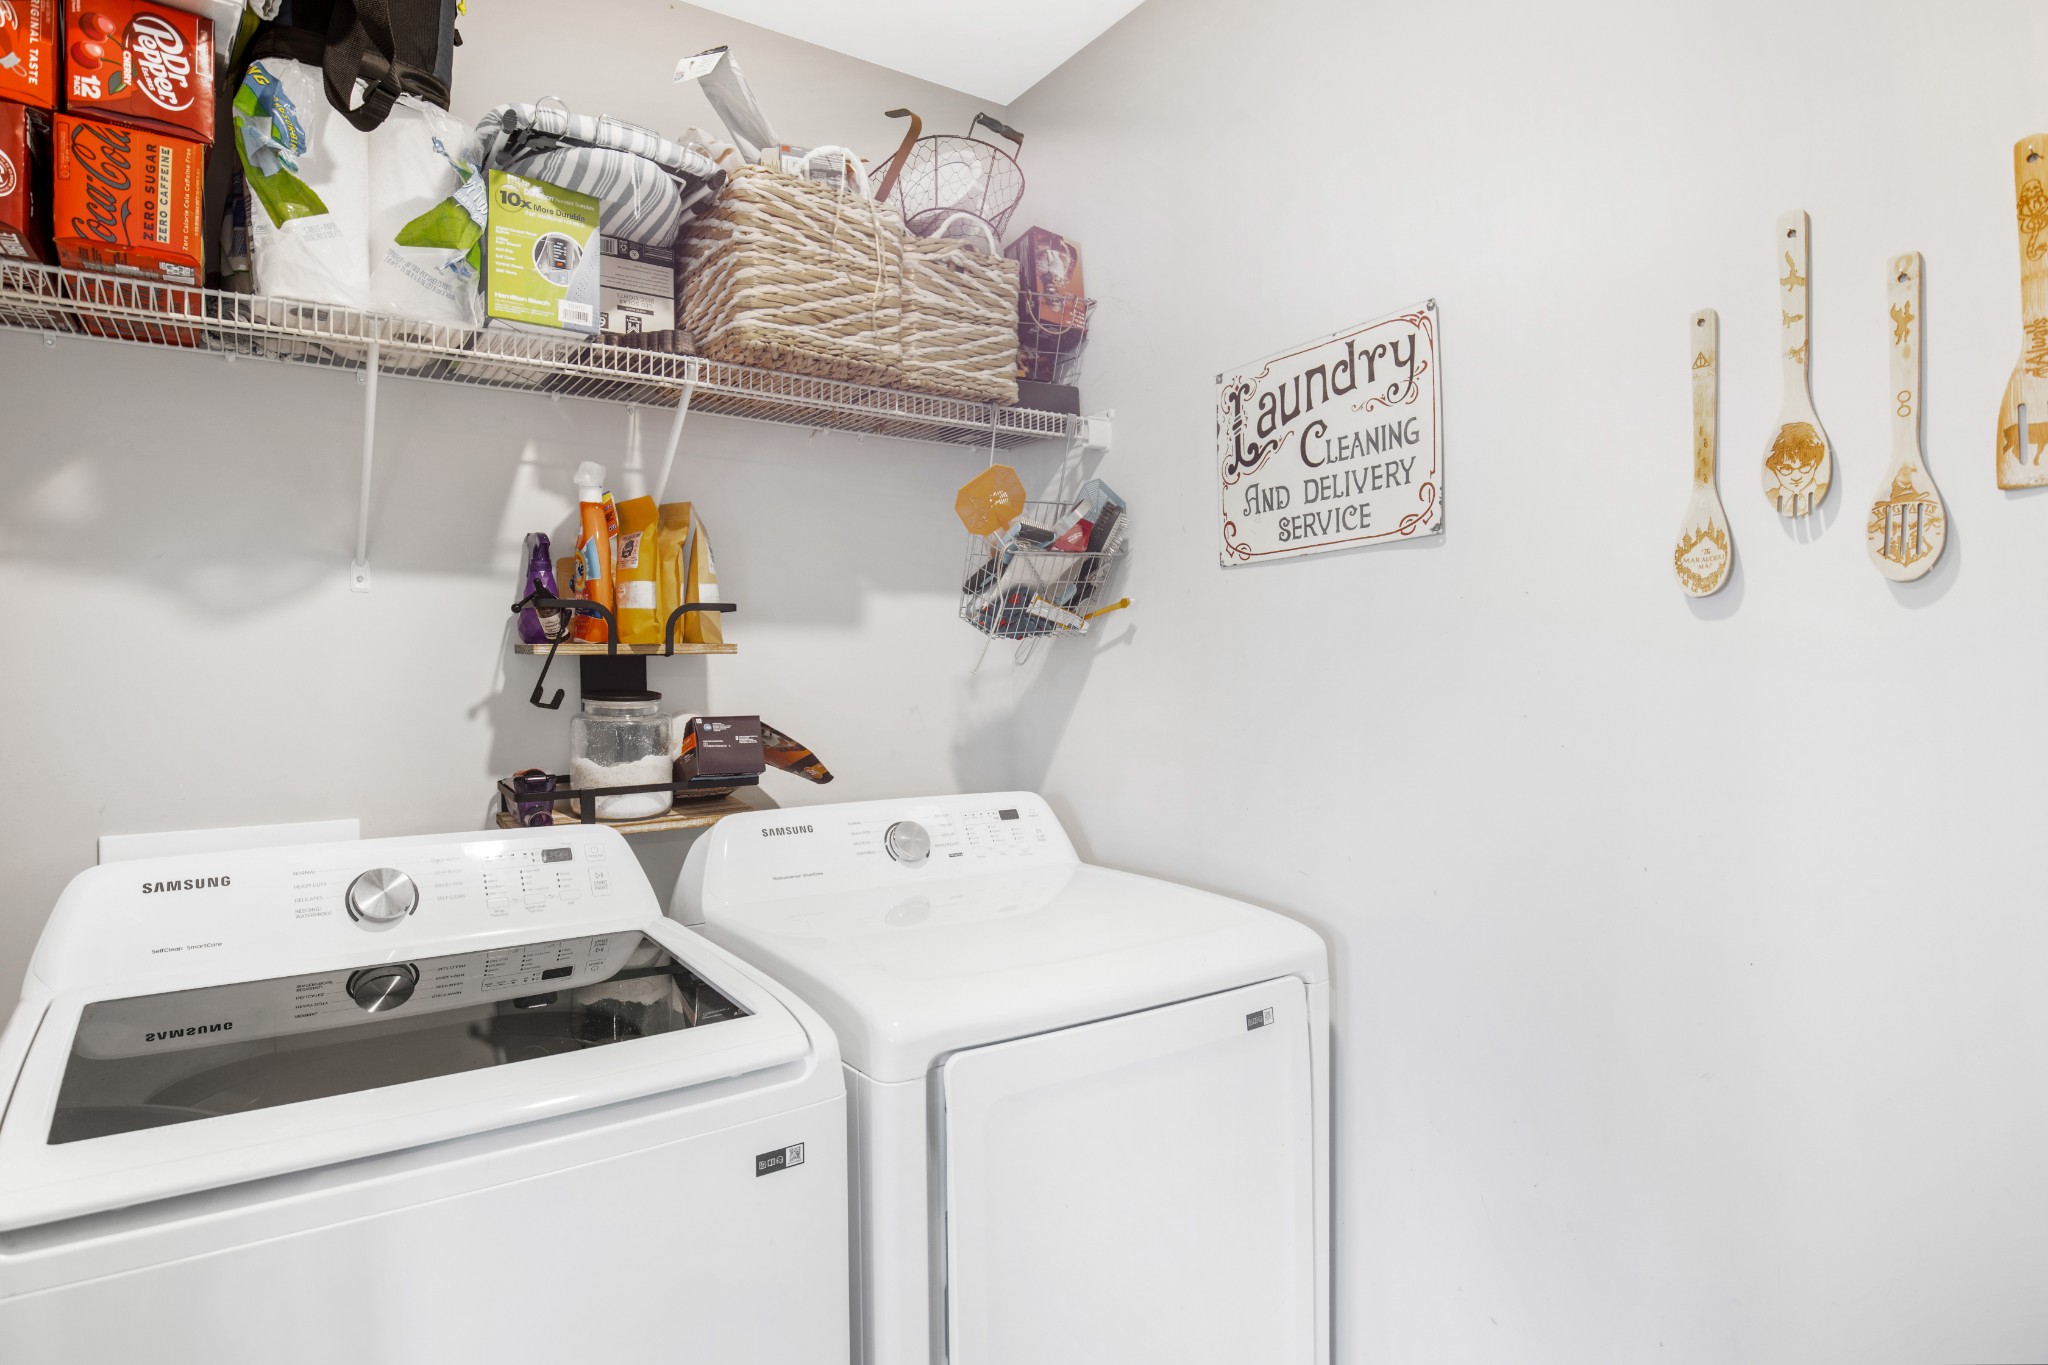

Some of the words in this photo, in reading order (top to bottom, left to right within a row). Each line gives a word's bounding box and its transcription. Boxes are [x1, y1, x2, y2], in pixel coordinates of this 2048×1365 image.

[28, 48, 38, 85] TASTE
[122, 50, 133, 86] CHERRY
[132, 17, 184, 105] Pepper
[159, 50, 190, 89] Dr
[73, 75, 82, 95] PACK
[81, 75, 101, 99] 12
[71, 122, 132, 243] Coca-Cola
[145, 144, 157, 194] SUGAR
[160, 147, 170, 206] CAFFEINE
[183, 193, 191, 208] Cola
[500, 190, 532, 210] 10x
[533, 204, 555, 216] More
[555, 209, 586, 223] Durable
[143, 201, 155, 241] ZERO
[158, 210, 168, 242] ZERO
[182, 209, 191, 234] Calorie
[182, 236, 190, 251] Zero
[494, 291, 527, 303] Hamilton
[528, 297, 551, 306] Beach
[616, 292, 639, 302] LIGHTS
[618, 299, 640, 308] SOLAR
[1227, 333, 1417, 476] Laundry
[1300, 416, 1420, 468] CLEANING
[1304, 456, 1416, 505] DELIVERY
[1278, 503, 1372, 543] SERVICE
[1872, 504, 1937, 520] HOGATS
[761, 825, 814, 838] SAMSUNG
[142, 875, 231, 895] SAMSUNG
[294, 895, 324, 903] DELICATES
[151, 946, 183, 955] SelfClean
[186, 941, 223, 951] SmartCare
